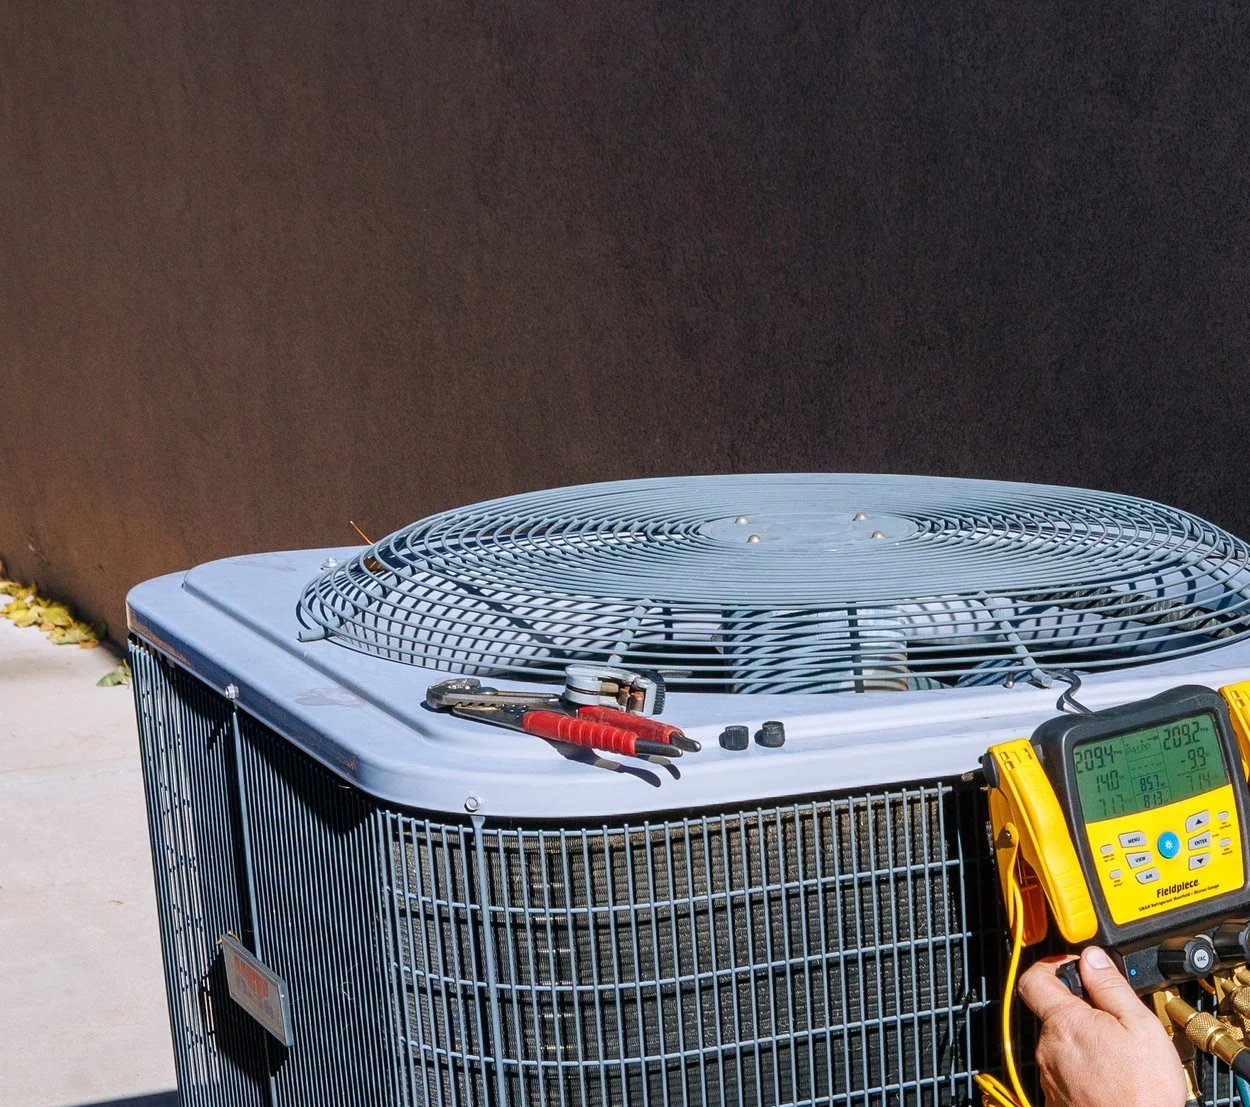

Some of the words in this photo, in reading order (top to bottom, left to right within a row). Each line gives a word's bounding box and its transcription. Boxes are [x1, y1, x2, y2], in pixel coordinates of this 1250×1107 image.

[1194, 838, 1207, 846] ENTER
[1156, 879, 1199, 898] Fieldpiece
[1173, 892, 1190, 901] Manifold
